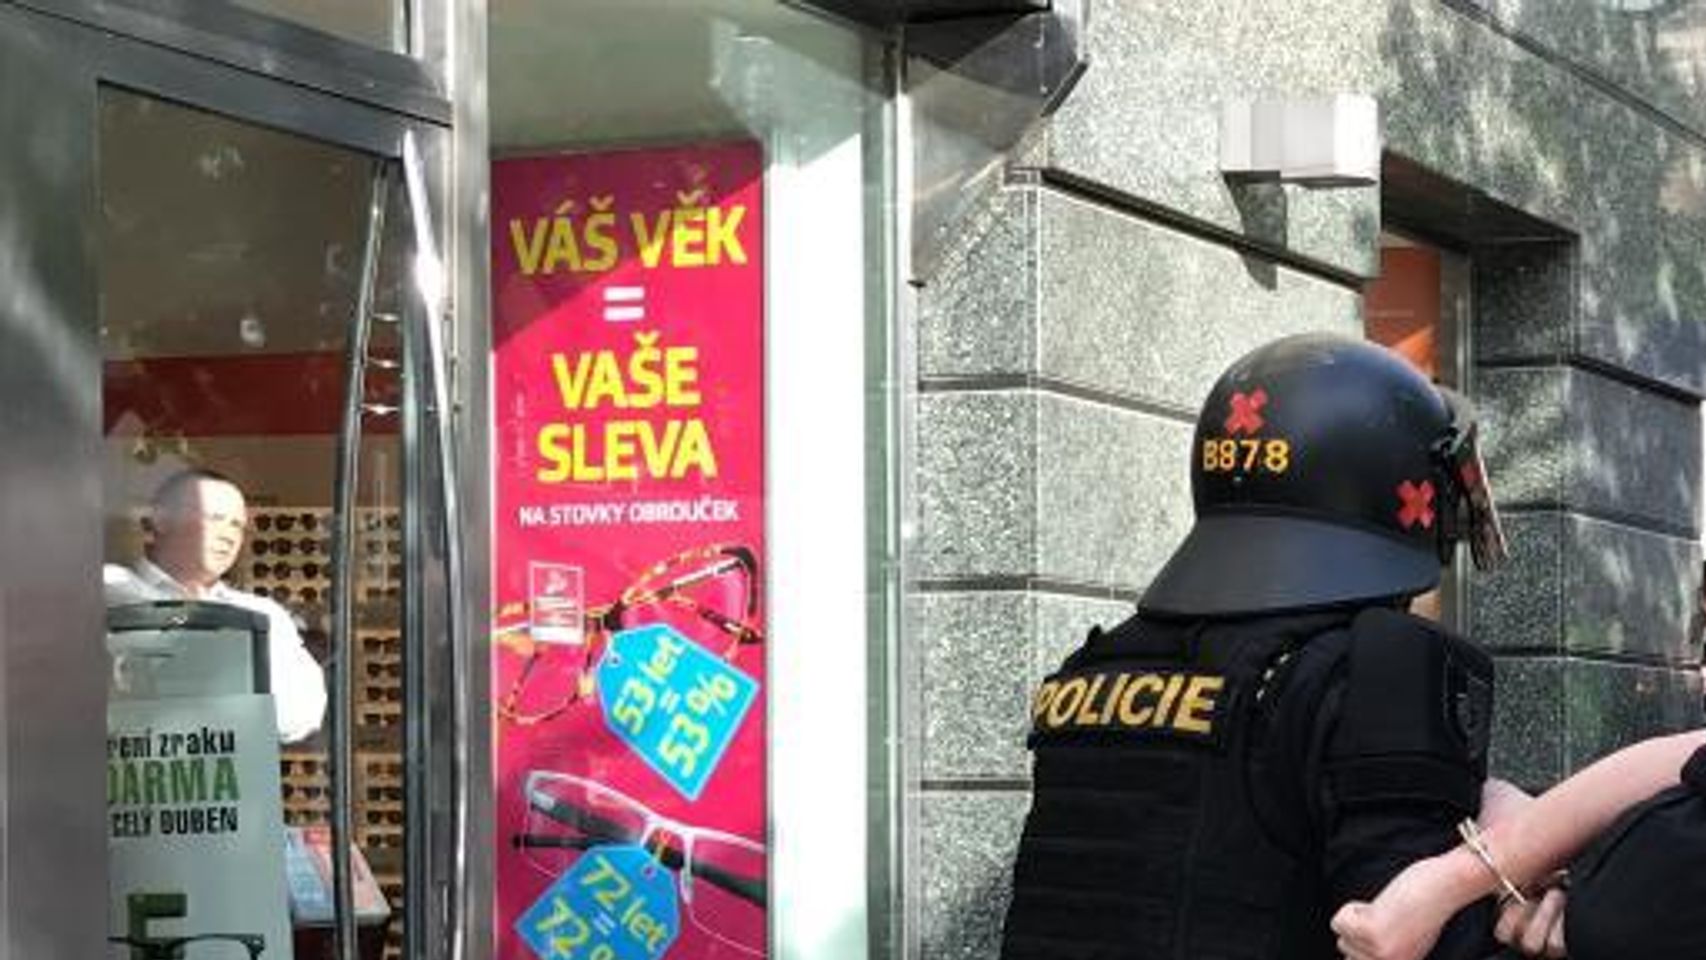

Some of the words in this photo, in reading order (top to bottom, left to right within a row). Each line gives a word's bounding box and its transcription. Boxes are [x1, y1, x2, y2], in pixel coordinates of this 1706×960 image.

[510, 196, 617, 274] VÁŠ
[630, 189, 748, 267] VĚK
[552, 330, 702, 409] VAŠE
[536, 419, 718, 484] SLEVA
[1203, 439, 1290, 473] B878
[519, 505, 547, 528] NA
[550, 502, 623, 524] STOVKY
[628, 495, 739, 522] OBROUČEK
[637, 636, 685, 684] let
[659, 713, 710, 778] 53
[686, 673, 737, 716] %
[1032, 672, 1225, 733] POLICIE
[159, 727, 235, 758] zraku
[160, 807, 238, 835] DUBEN
[536, 896, 591, 960] 72
[581, 855, 632, 913] 72
[621, 897, 668, 953] let
